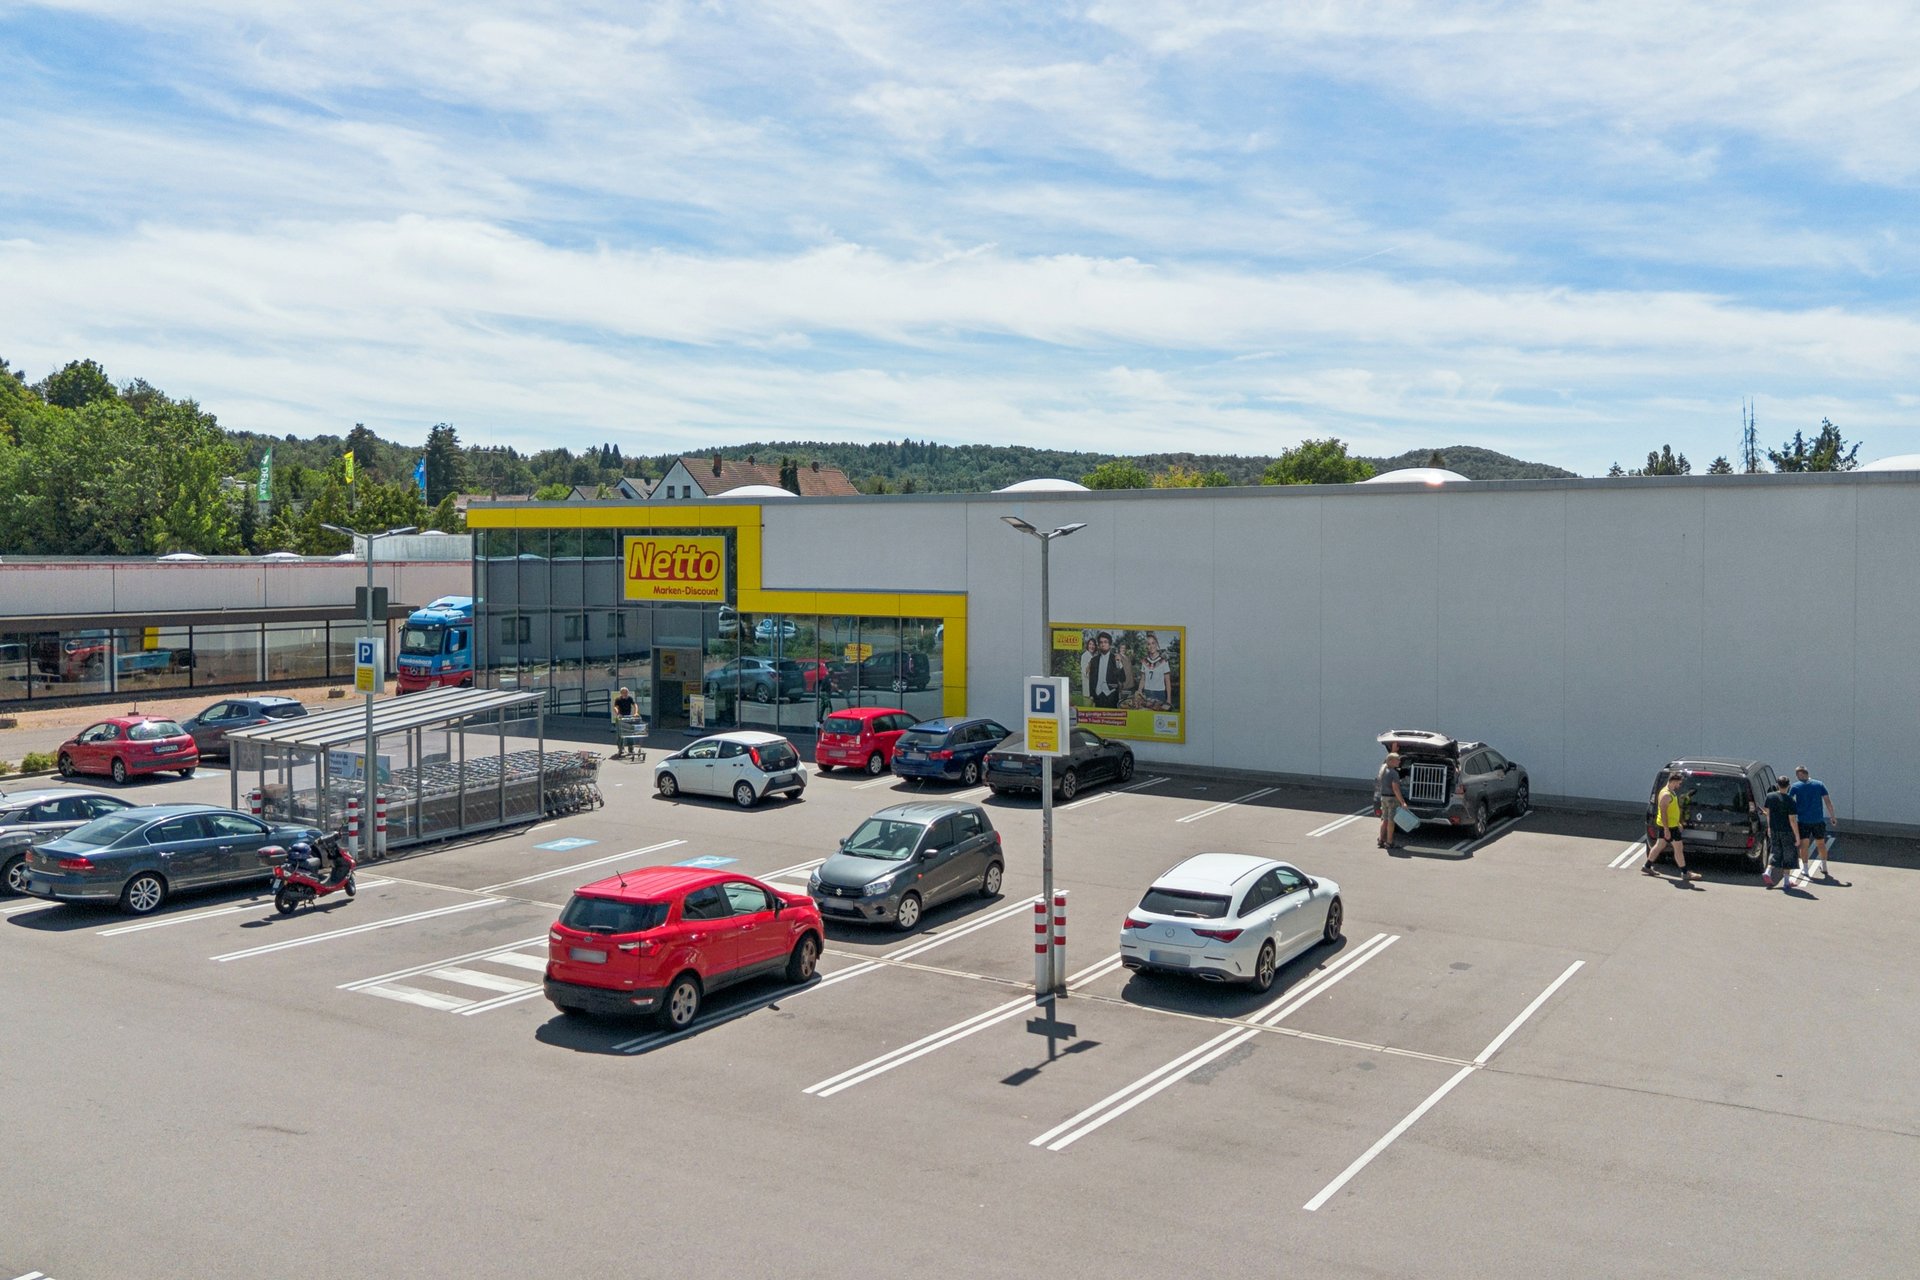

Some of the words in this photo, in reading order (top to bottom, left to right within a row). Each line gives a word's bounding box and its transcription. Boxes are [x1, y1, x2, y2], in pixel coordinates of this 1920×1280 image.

[259, 467, 269, 496] DEKRA
[629, 542, 720, 581] Netto
[653, 585, 719, 597] Marken-Discount
[362, 646, 371, 661] P
[1036, 688, 1050, 709] P
